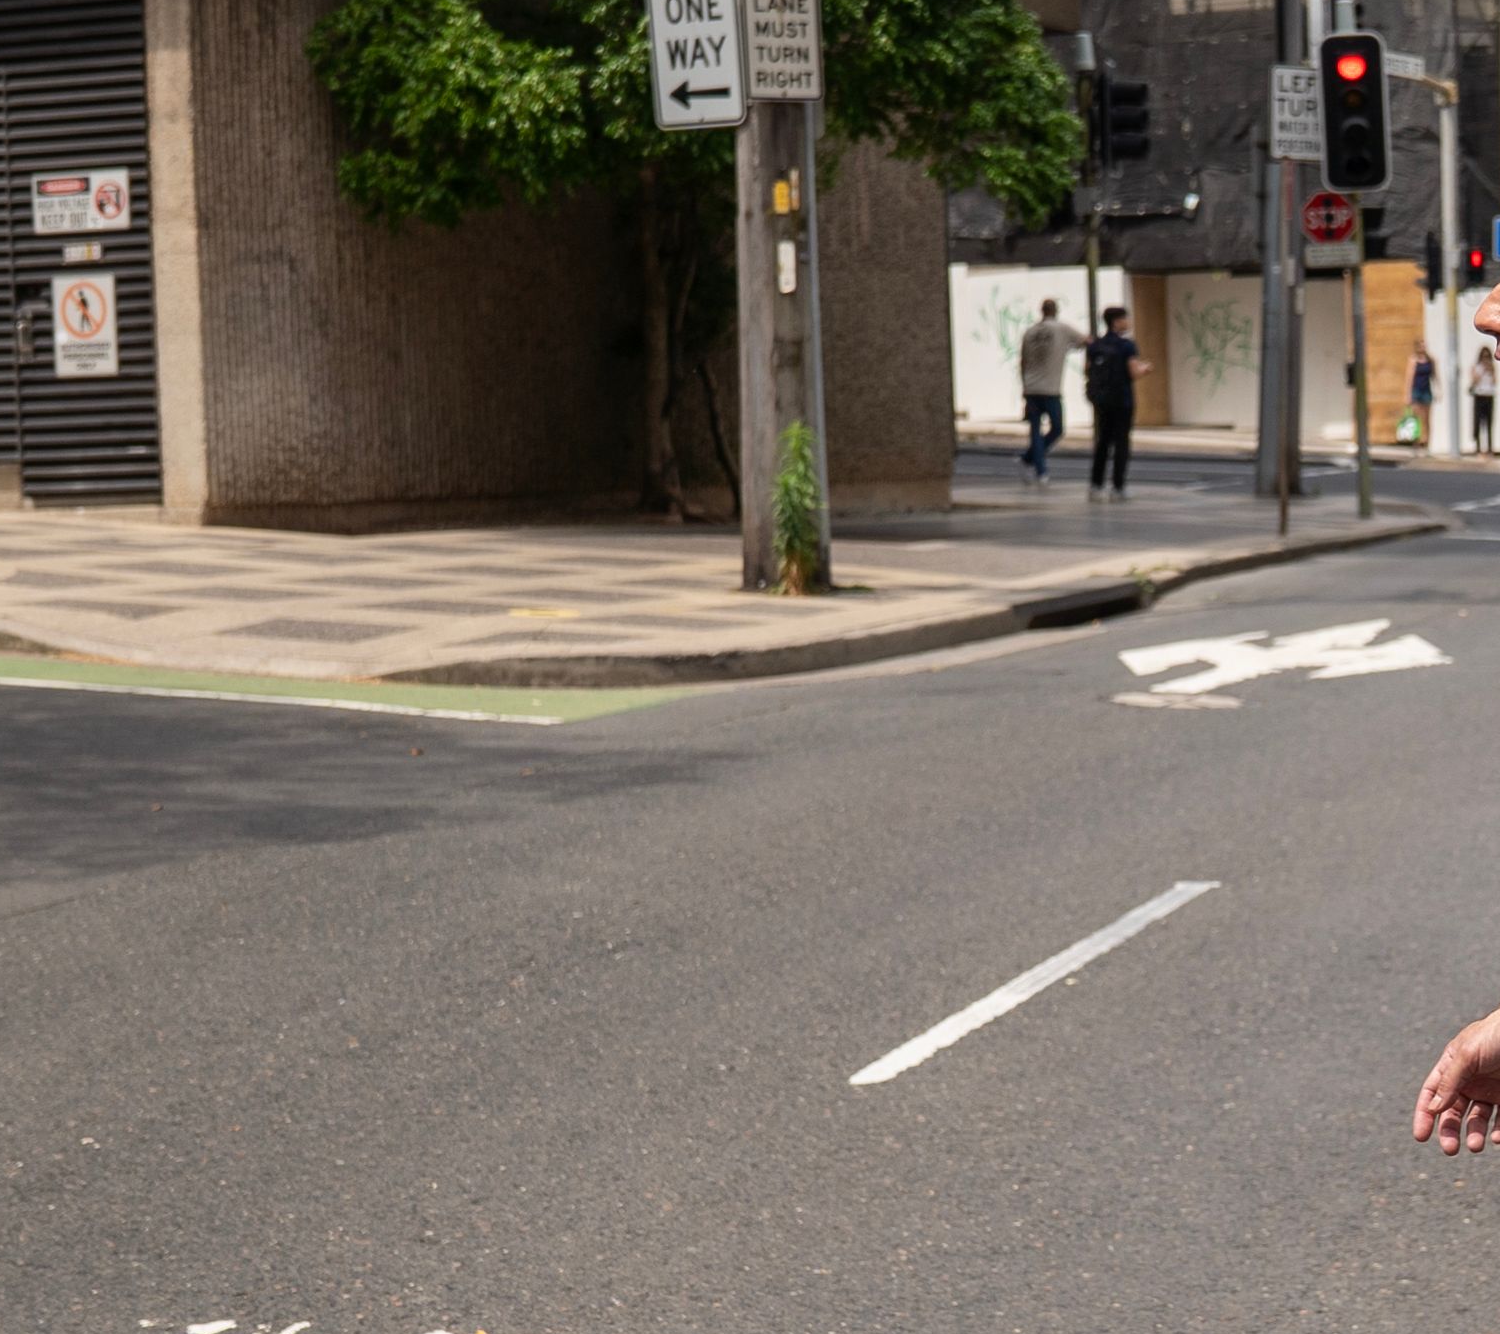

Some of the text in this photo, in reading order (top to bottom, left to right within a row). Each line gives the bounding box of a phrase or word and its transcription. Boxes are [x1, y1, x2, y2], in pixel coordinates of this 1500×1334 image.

[755, 21, 809, 39] MUST
[666, 35, 727, 71] WAY
[756, 45, 810, 64] TURN
[756, 70, 813, 89] RIGHT
[1280, 75, 1317, 94] LEF
[1277, 98, 1319, 117] TUR
